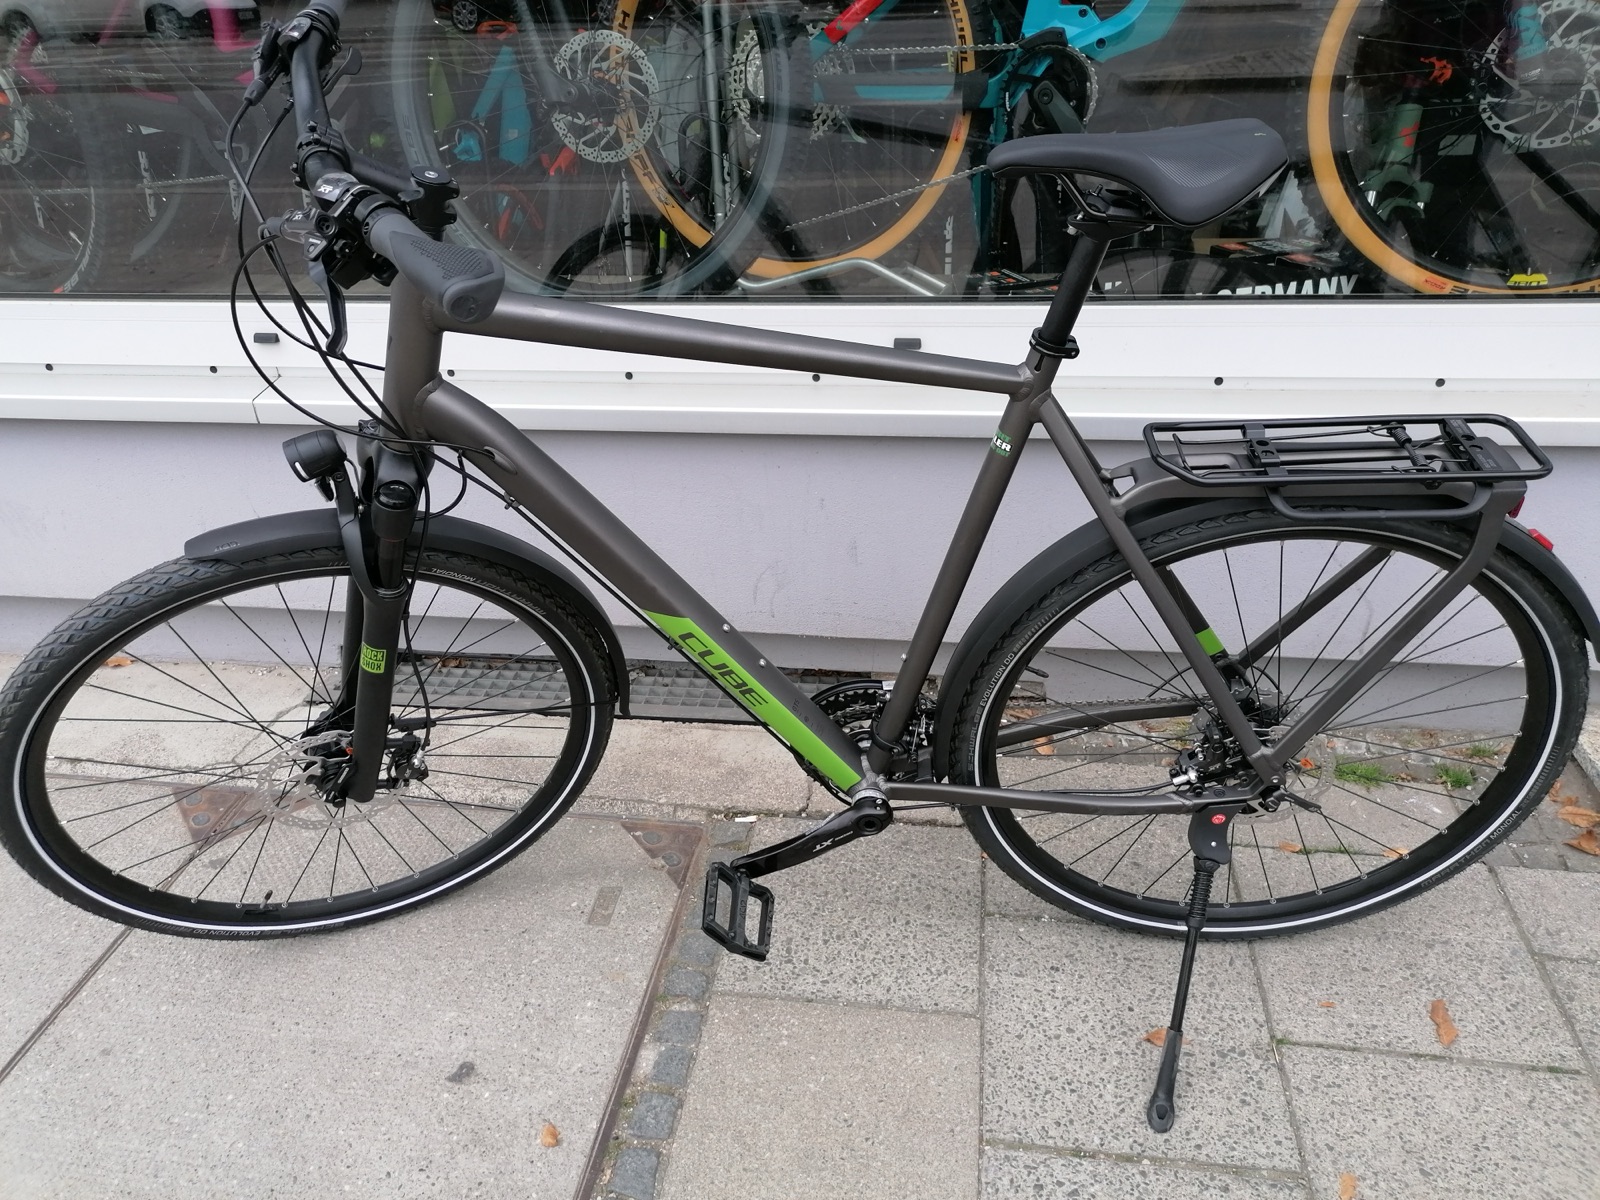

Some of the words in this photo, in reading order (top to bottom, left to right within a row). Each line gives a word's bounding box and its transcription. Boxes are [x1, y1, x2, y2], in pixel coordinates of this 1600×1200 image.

[431, 567, 477, 582] MONDIAL
[363, 646, 384, 661] ROCK
[678, 632, 769, 707] CUBE
[980, 666, 1006, 707] EVOLUTION
[1004, 653, 1015, 665] DD
[1489, 809, 1523, 840] MONDIAL
